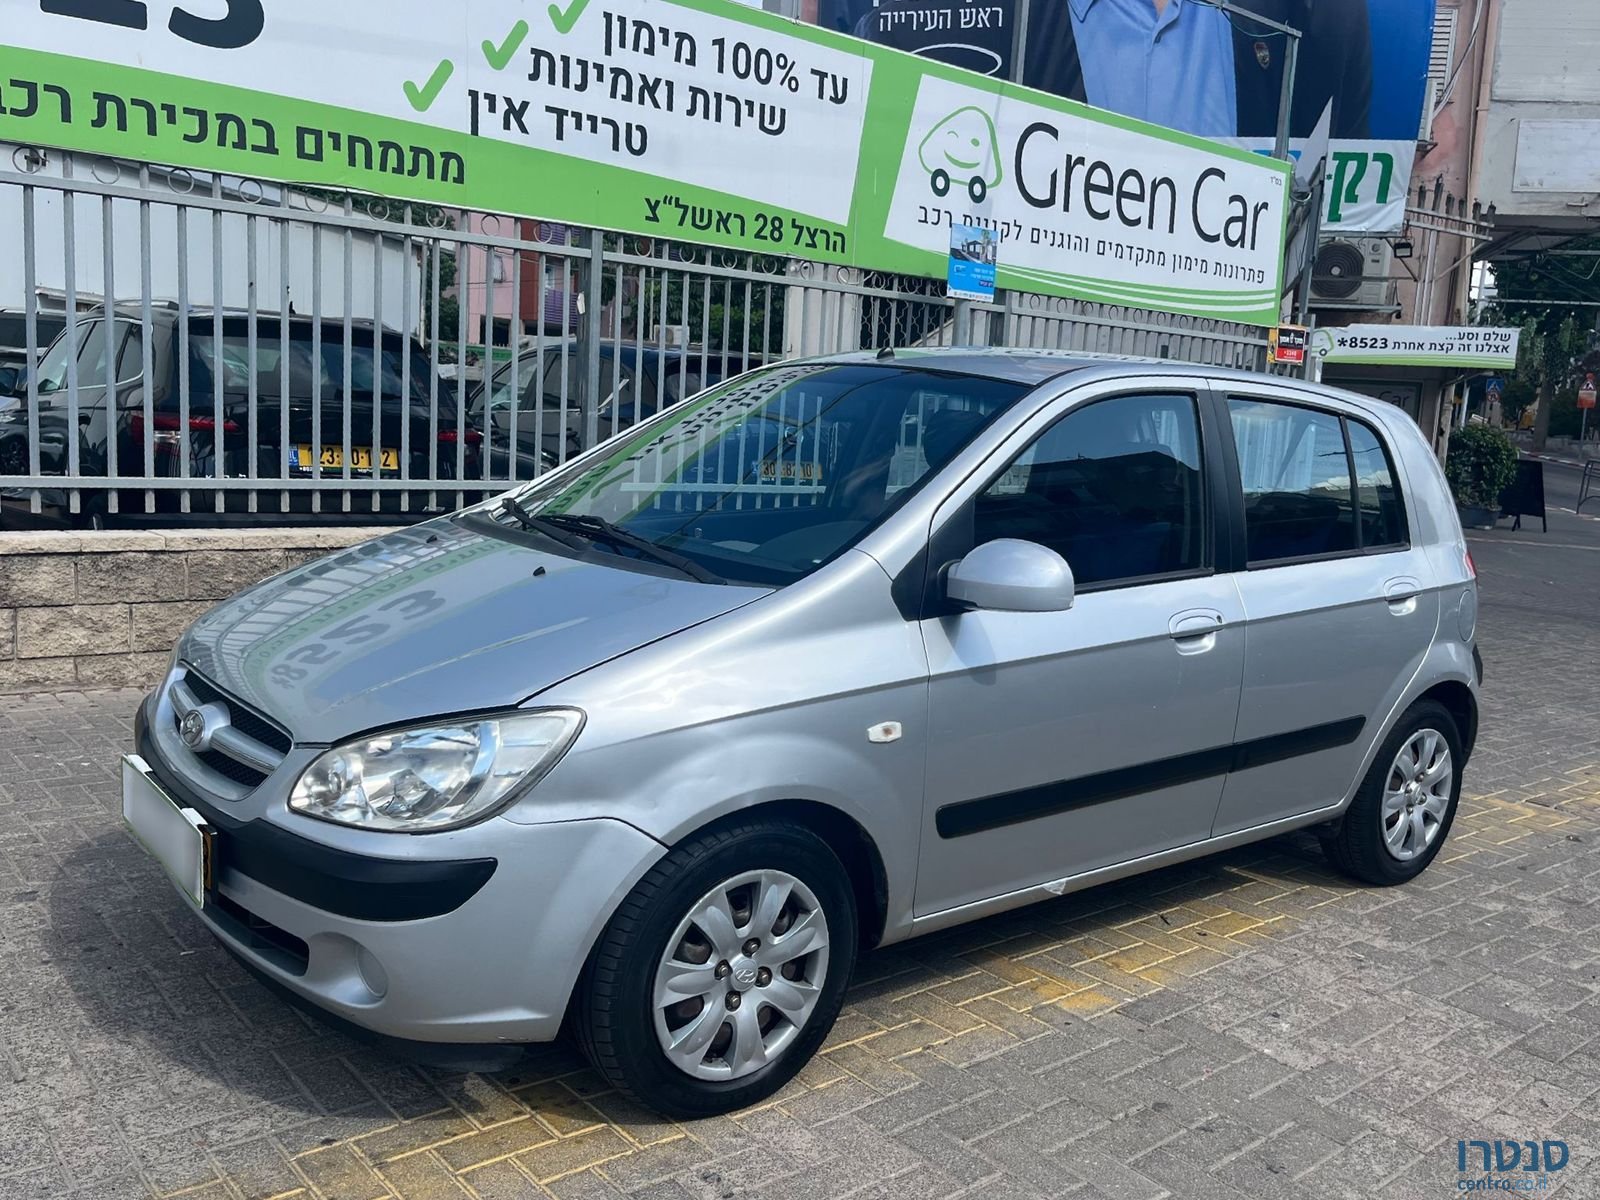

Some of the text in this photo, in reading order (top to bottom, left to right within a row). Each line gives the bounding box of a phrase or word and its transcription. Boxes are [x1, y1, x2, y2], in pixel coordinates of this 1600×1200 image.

[880, 7, 1003, 32] ראש העירייה
[603, 11, 849, 105] עד 100% מימון
[528, 47, 787, 136] שירות ואמינות
[0, 78, 466, 185] מתמחים במכירת רכ
[468, 89, 648, 157] טרייד אין
[1014, 122, 1269, 252] Green Car
[754, 213, 784, 243] 28
[918, 205, 953, 229] רכב
[791, 218, 846, 254] הרצל
[1030, 227, 1089, 253] והוגנים
[1097, 240, 1166, 267] מתקדמים
[1172, 254, 1208, 274] מימון
[1213, 261, 1265, 284] פתרונות
[1392, 342, 1426, 351] אחרת
[1429, 342, 1455, 354] קצת
[1458, 343, 1472, 353] זה
[1475, 343, 1510, 354] אצלנו
[1483, 331, 1511, 342] שלם
